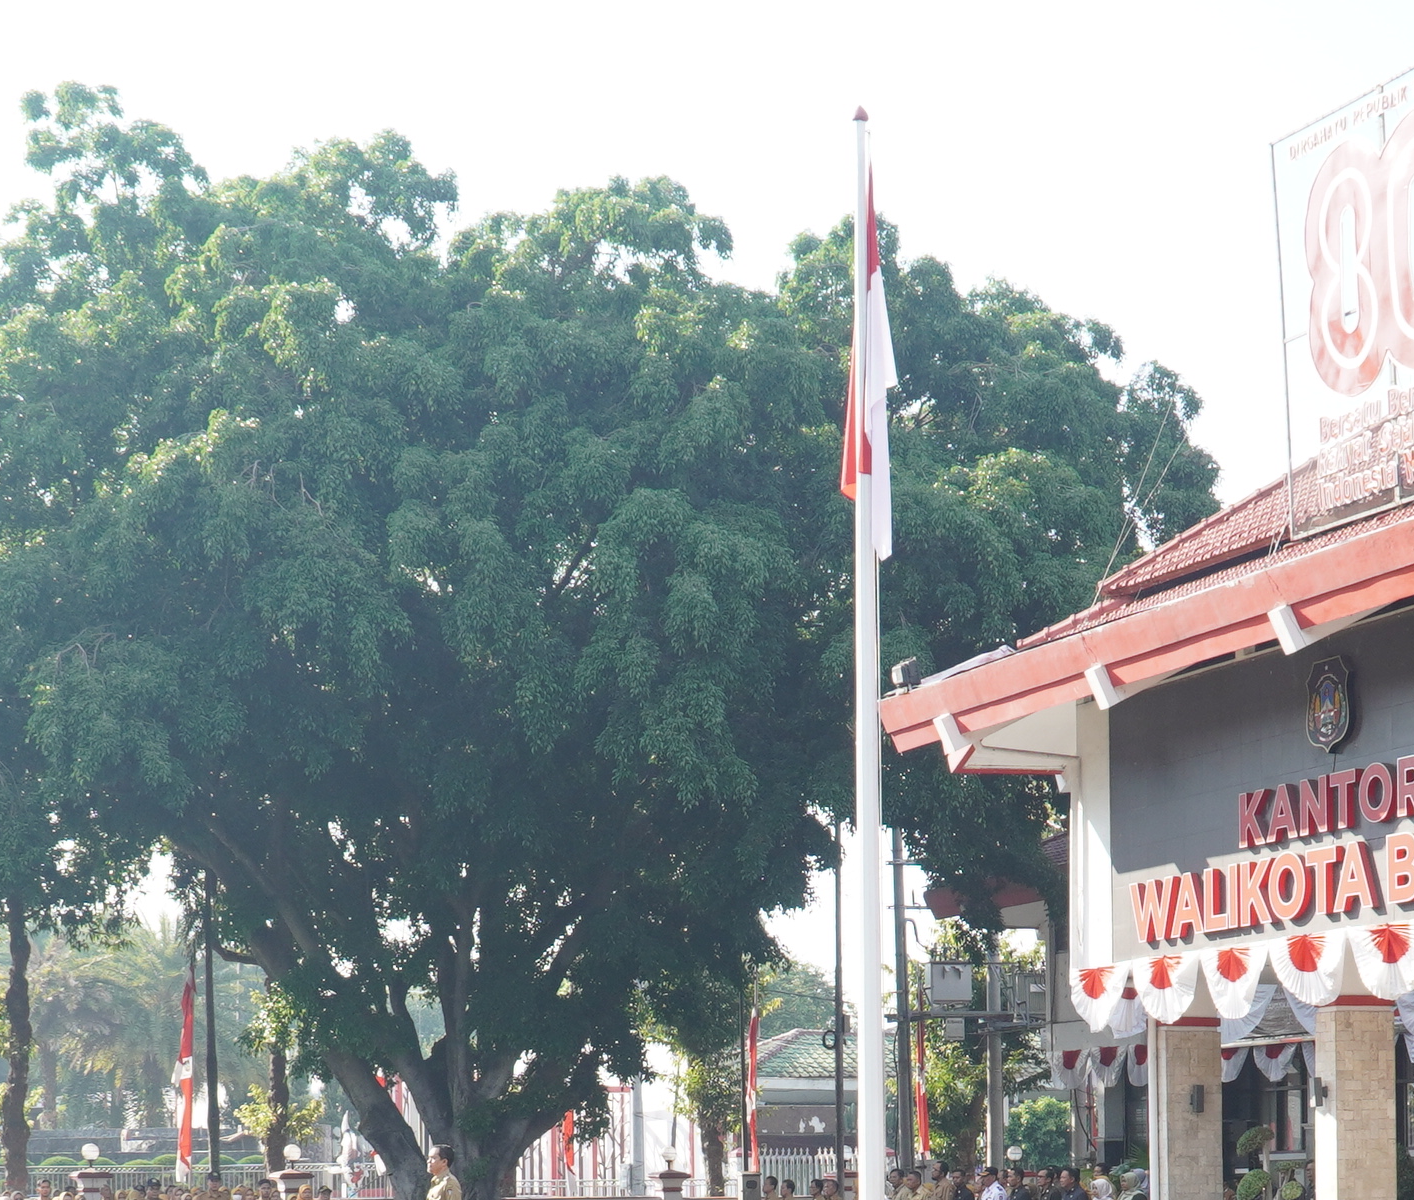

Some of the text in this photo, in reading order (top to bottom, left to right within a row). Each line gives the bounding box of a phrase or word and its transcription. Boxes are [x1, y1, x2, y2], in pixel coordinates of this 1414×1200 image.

[1319, 400, 1382, 444] Bersatu
[1316, 458, 1399, 511] Indonesia
[1128, 840, 1378, 944] WALIKOTA
